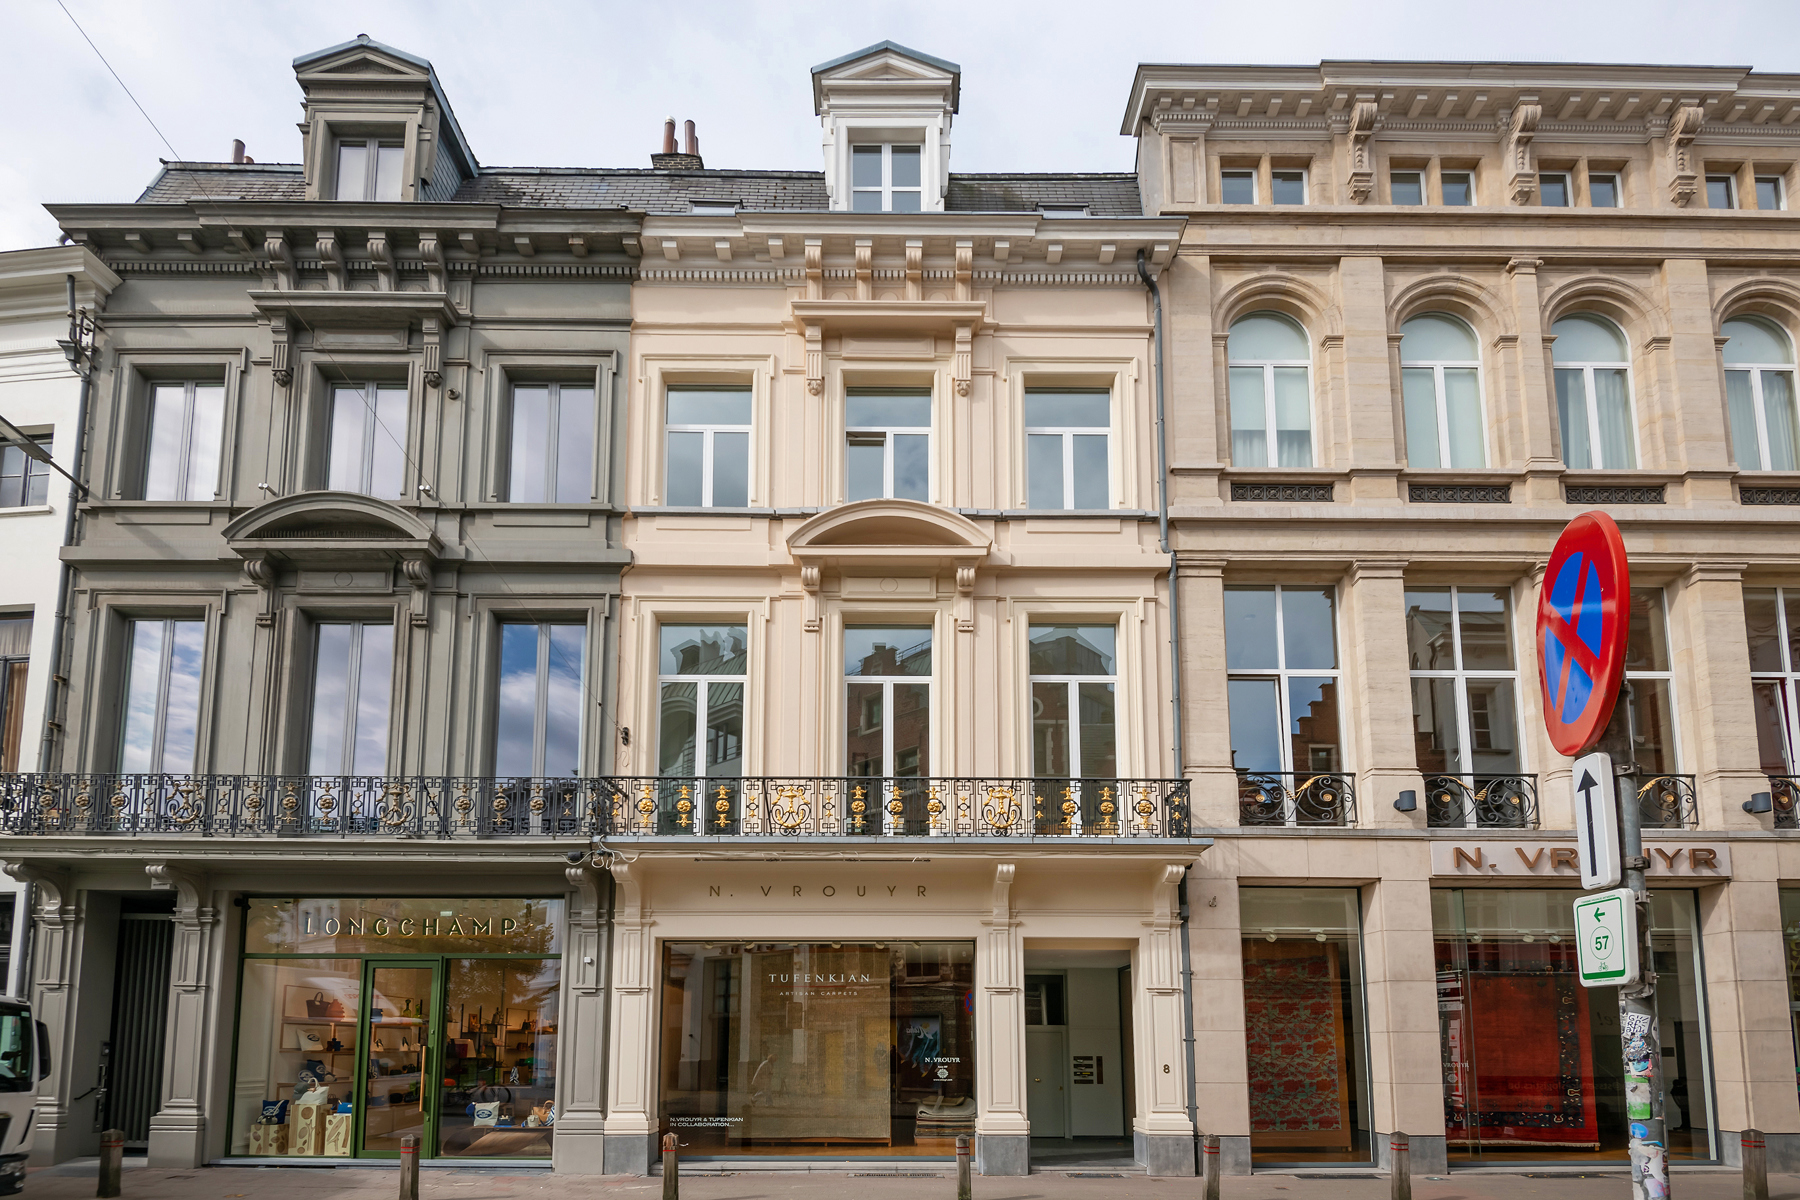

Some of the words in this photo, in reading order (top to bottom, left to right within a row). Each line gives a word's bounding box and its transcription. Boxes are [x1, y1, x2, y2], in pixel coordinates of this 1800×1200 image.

[1452, 846, 1498, 870] N.
[1514, 847, 1719, 870] VRYR
[709, 885, 734, 897] N.
[760, 886, 926, 897] VROUYR
[303, 916, 517, 937] LONGCHAMP
[1594, 935, 1610, 951] 57
[768, 973, 870, 983] TUFENKIAN
[1163, 1063, 1171, 1074] 8
